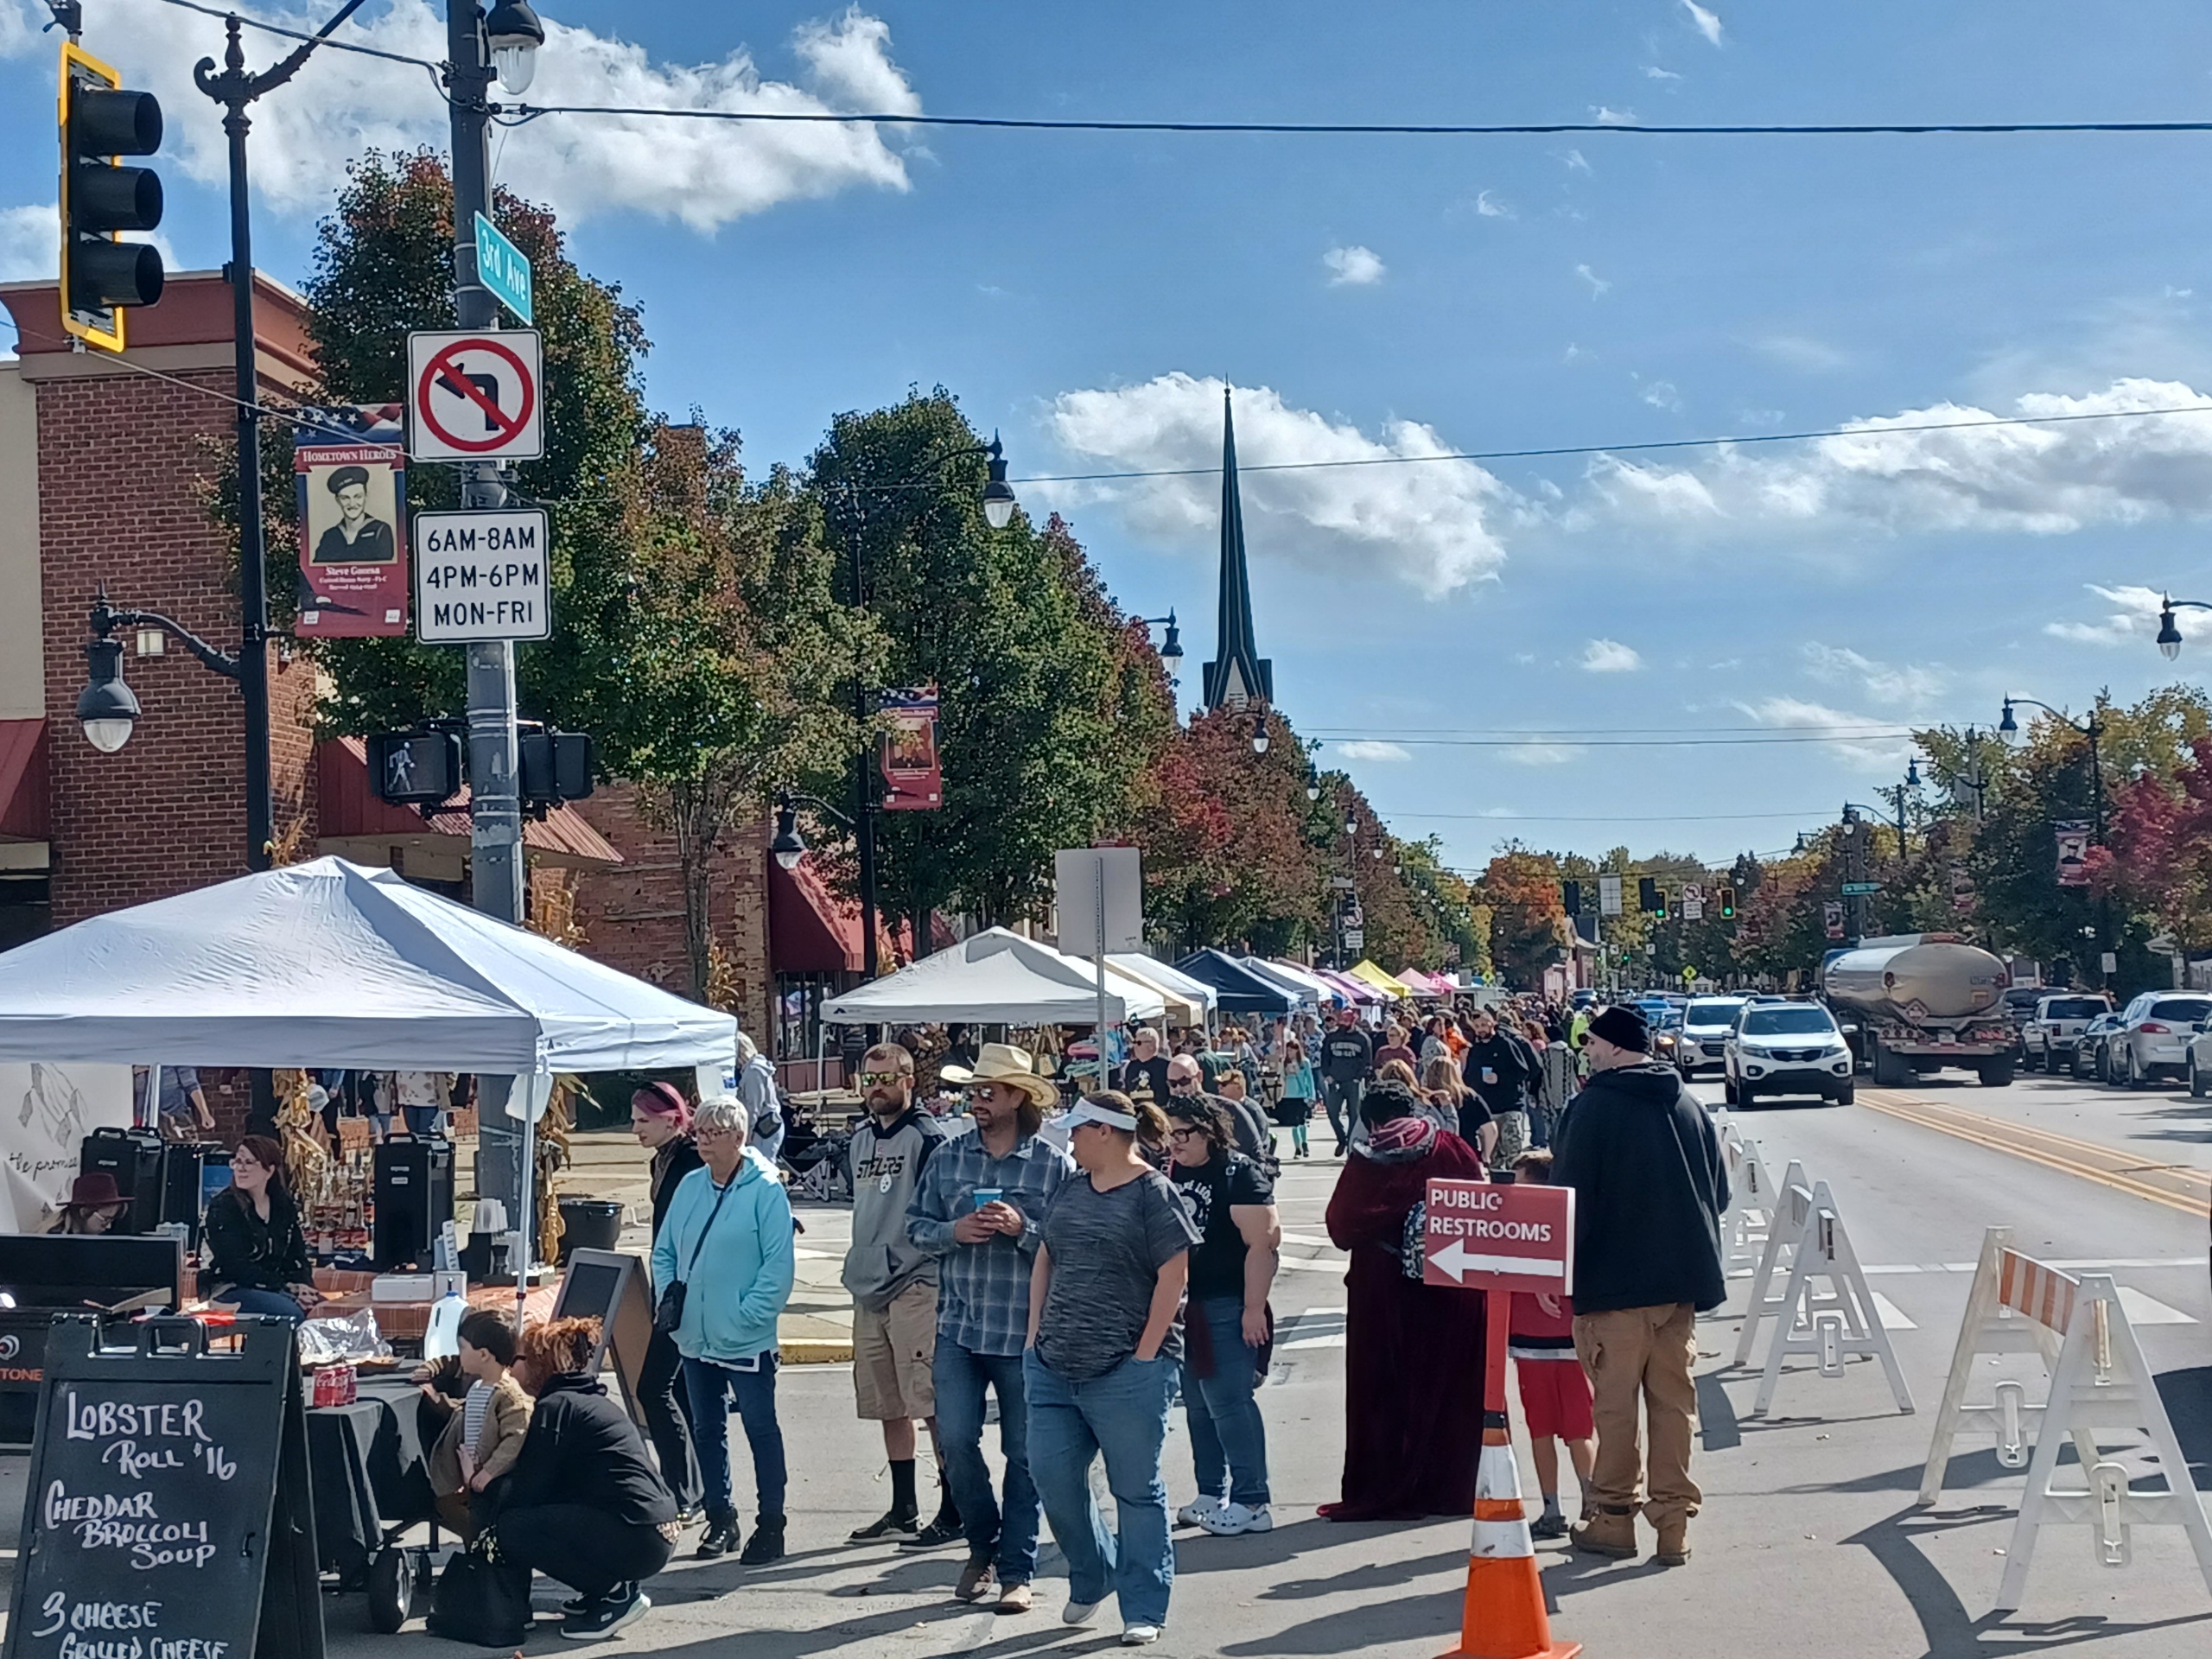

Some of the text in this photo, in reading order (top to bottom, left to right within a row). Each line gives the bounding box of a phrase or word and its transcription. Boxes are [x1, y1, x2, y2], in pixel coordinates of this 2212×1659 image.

[482, 229, 526, 301] 3rd Ave
[428, 526, 535, 552] 6AM-8AM
[426, 563, 538, 588] 4PM-6PM
[434, 600, 532, 626] MON-FRI
[1431, 1188, 1499, 1211] PUBLIC
[1430, 1216, 1552, 1242] RESTROOMS
[0, 1368, 43, 1381] TONE
[67, 1391, 213, 1442] LOBSTER
[102, 1440, 184, 1479] ROLL
[45, 1479, 158, 1529] CHEDDAR
[130, 1542, 216, 1570] SOUP
[32, 1591, 162, 1637] 3 CHEESE
